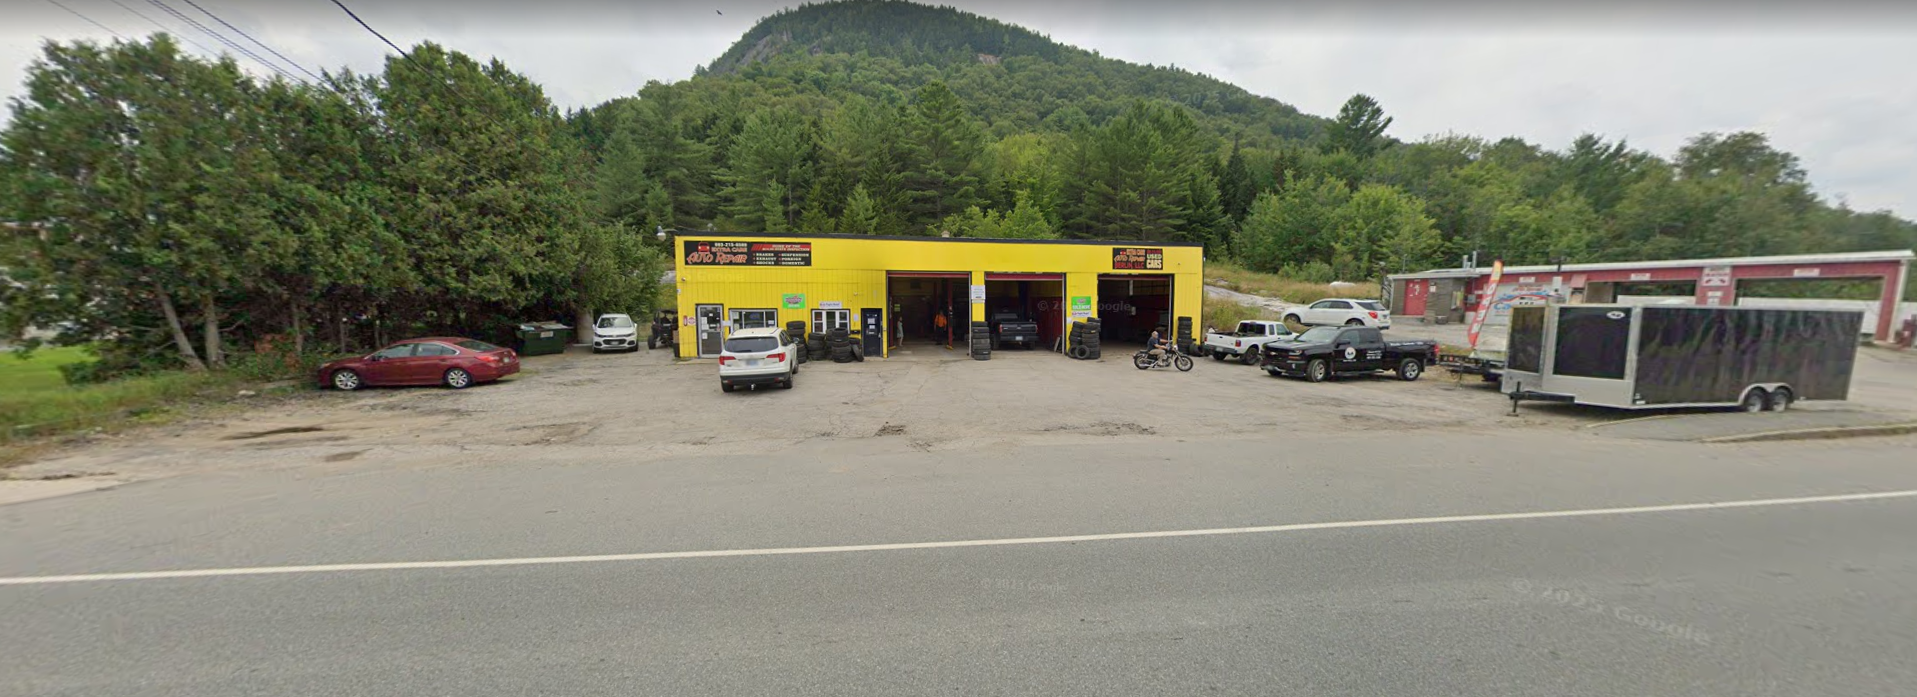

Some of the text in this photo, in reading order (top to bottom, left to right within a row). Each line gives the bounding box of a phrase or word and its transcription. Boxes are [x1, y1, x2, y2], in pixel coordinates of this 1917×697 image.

[687, 251, 748, 264] AUTO REPAIR
[1146, 259, 1162, 269] CARS
